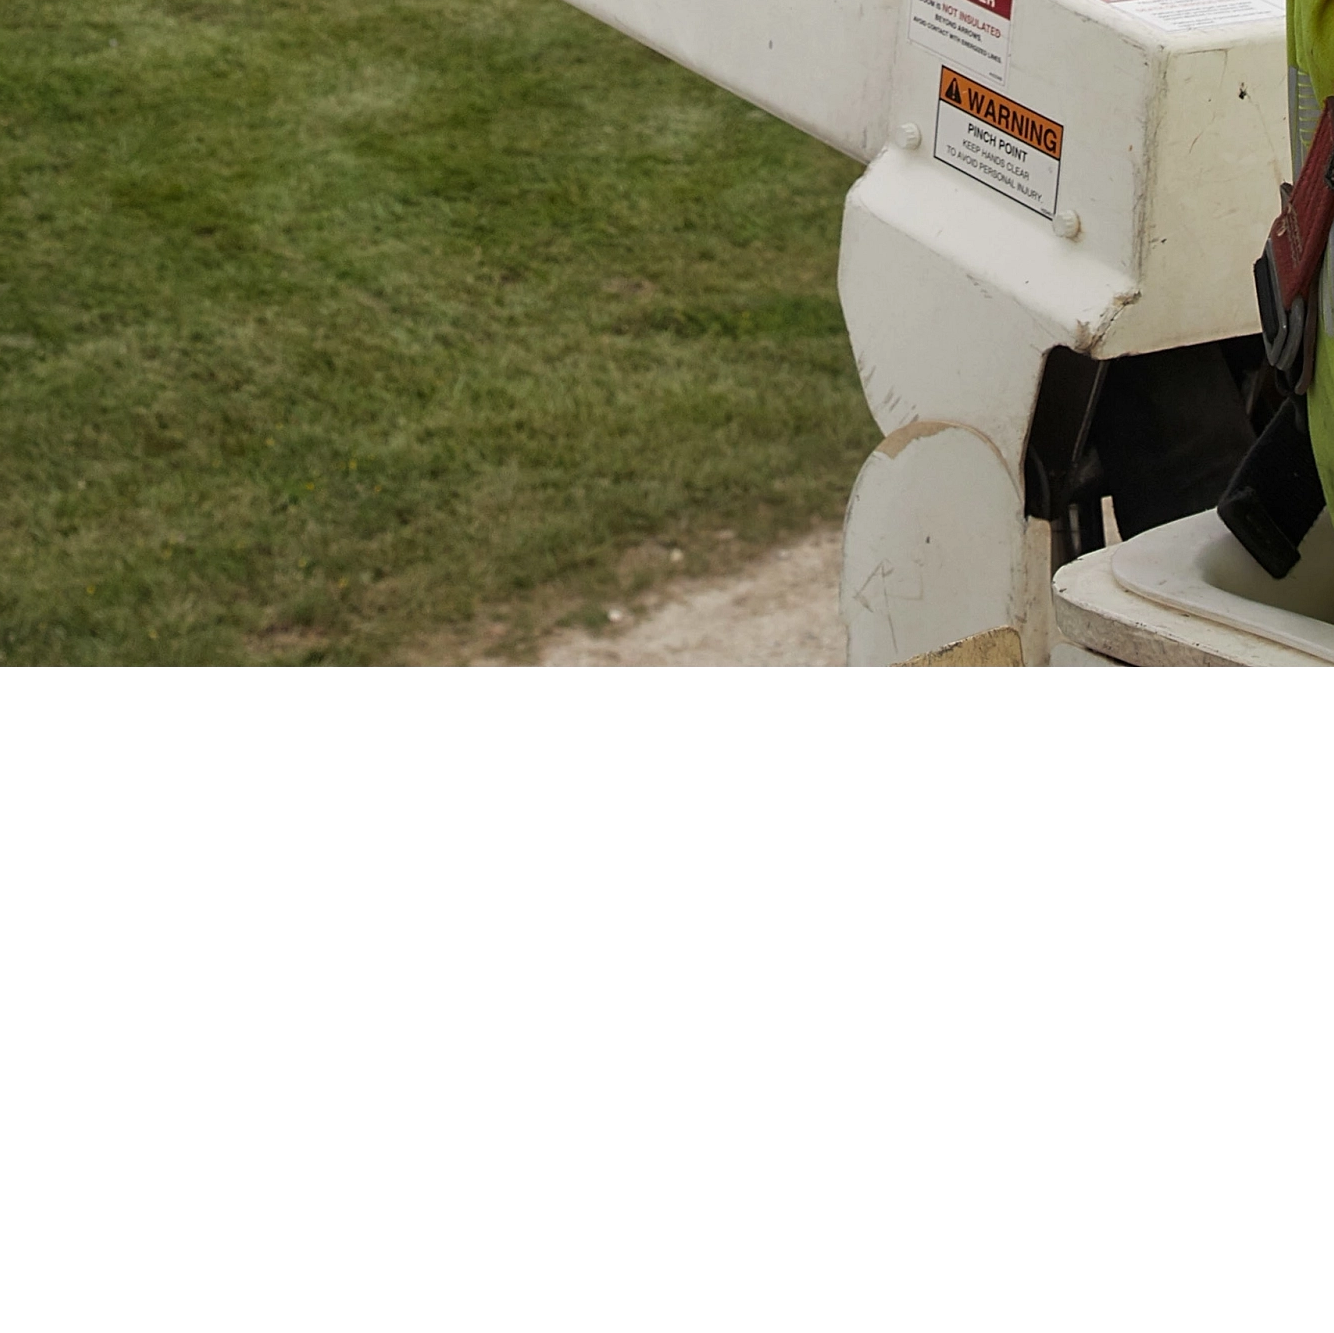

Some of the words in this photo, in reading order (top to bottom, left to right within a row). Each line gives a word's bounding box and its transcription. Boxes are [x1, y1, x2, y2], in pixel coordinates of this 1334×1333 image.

[942, 3, 958, 18] NOT
[959, 10, 1002, 39] INSULATED
[967, 87, 1057, 154] WARNING
[962, 139, 981, 153] KEEP
[982, 150, 1005, 168] HANDS
[1006, 162, 1030, 181] CLEAR
[967, 123, 997, 147] PINCH
[998, 139, 1028, 163] POINT
[946, 145, 956, 157] TO
[957, 151, 978, 169] AVOID
[979, 162, 1015, 189] PERSONAL
